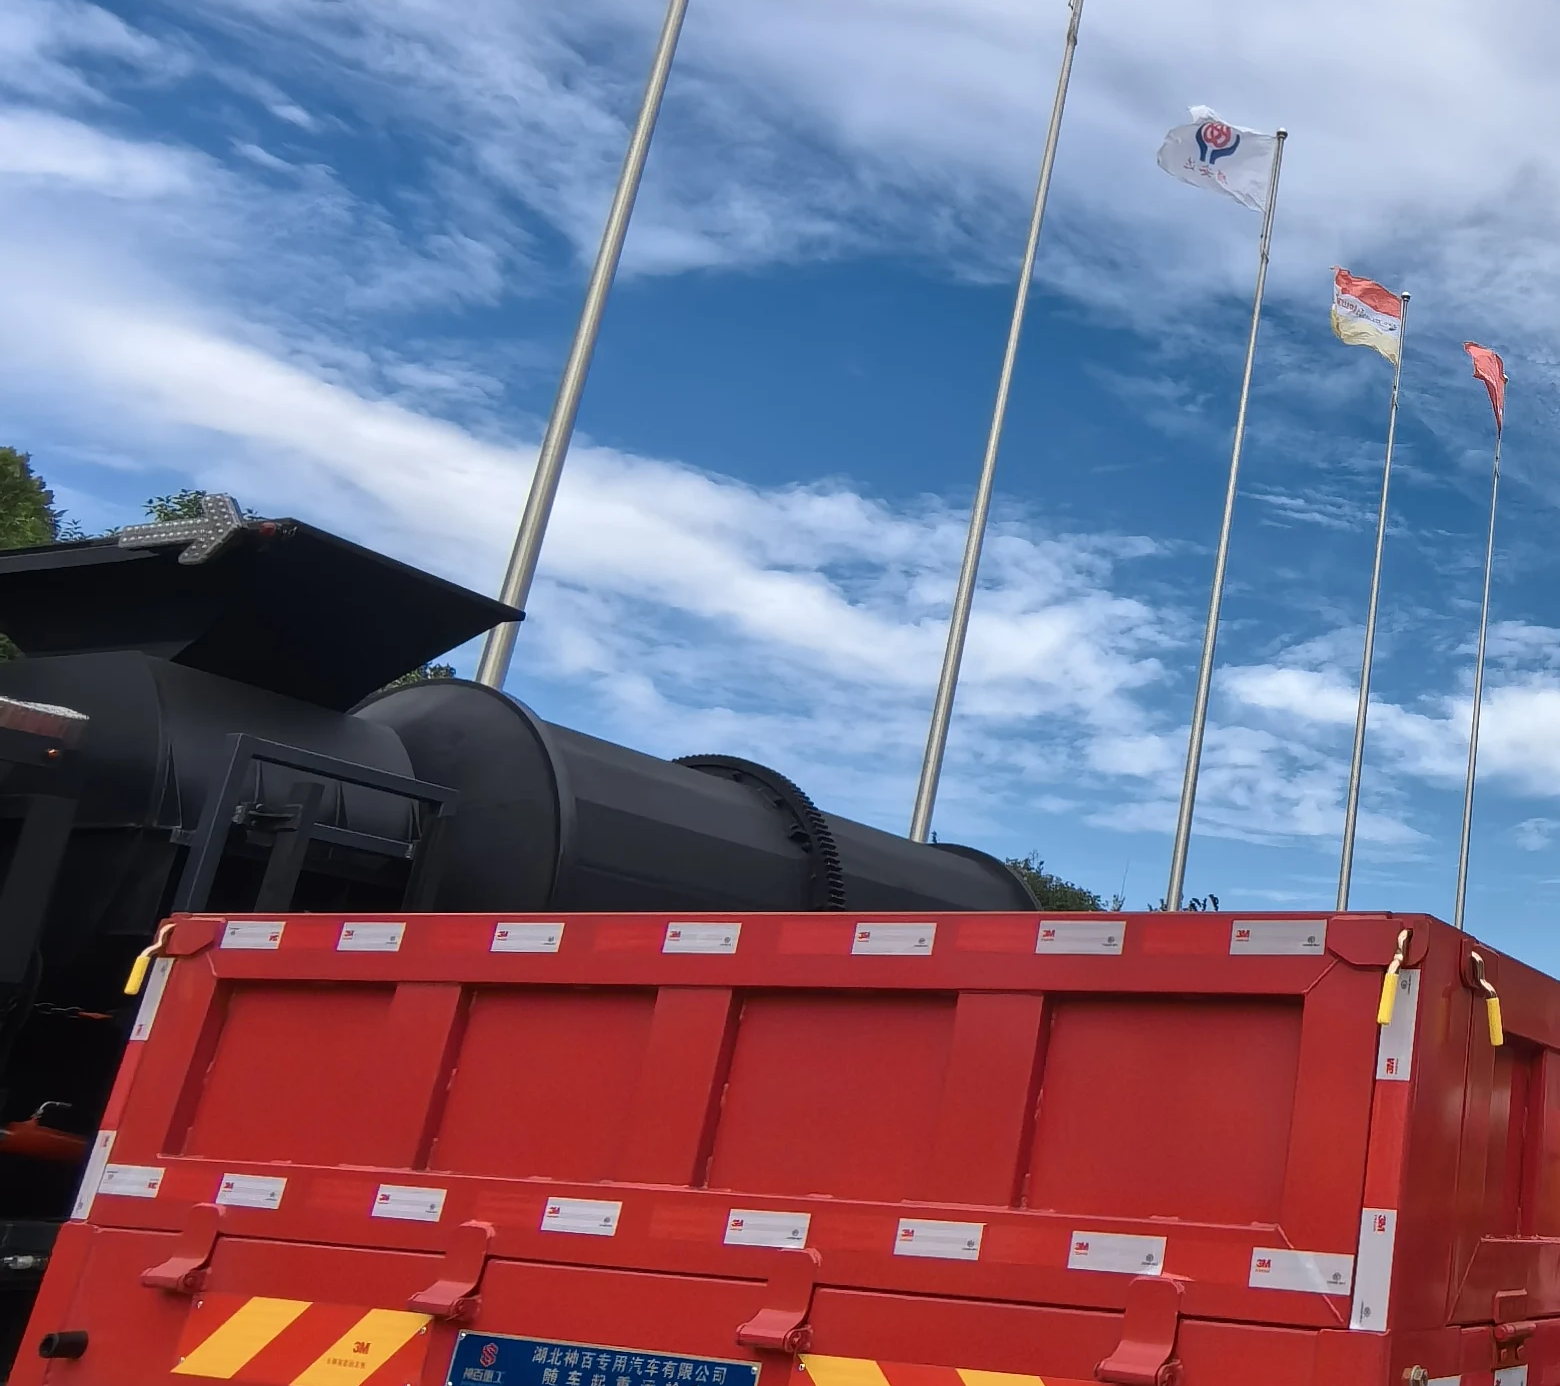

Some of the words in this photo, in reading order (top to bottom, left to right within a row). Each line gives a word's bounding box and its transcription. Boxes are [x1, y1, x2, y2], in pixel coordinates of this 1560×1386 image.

[1075, 1241, 1089, 1251] 3M
[1256, 1258, 1272, 1269] 3M
[352, 1341, 372, 1355] 3M
[531, 1345, 728, 1386] 湖北神百专用汽车有限公司
